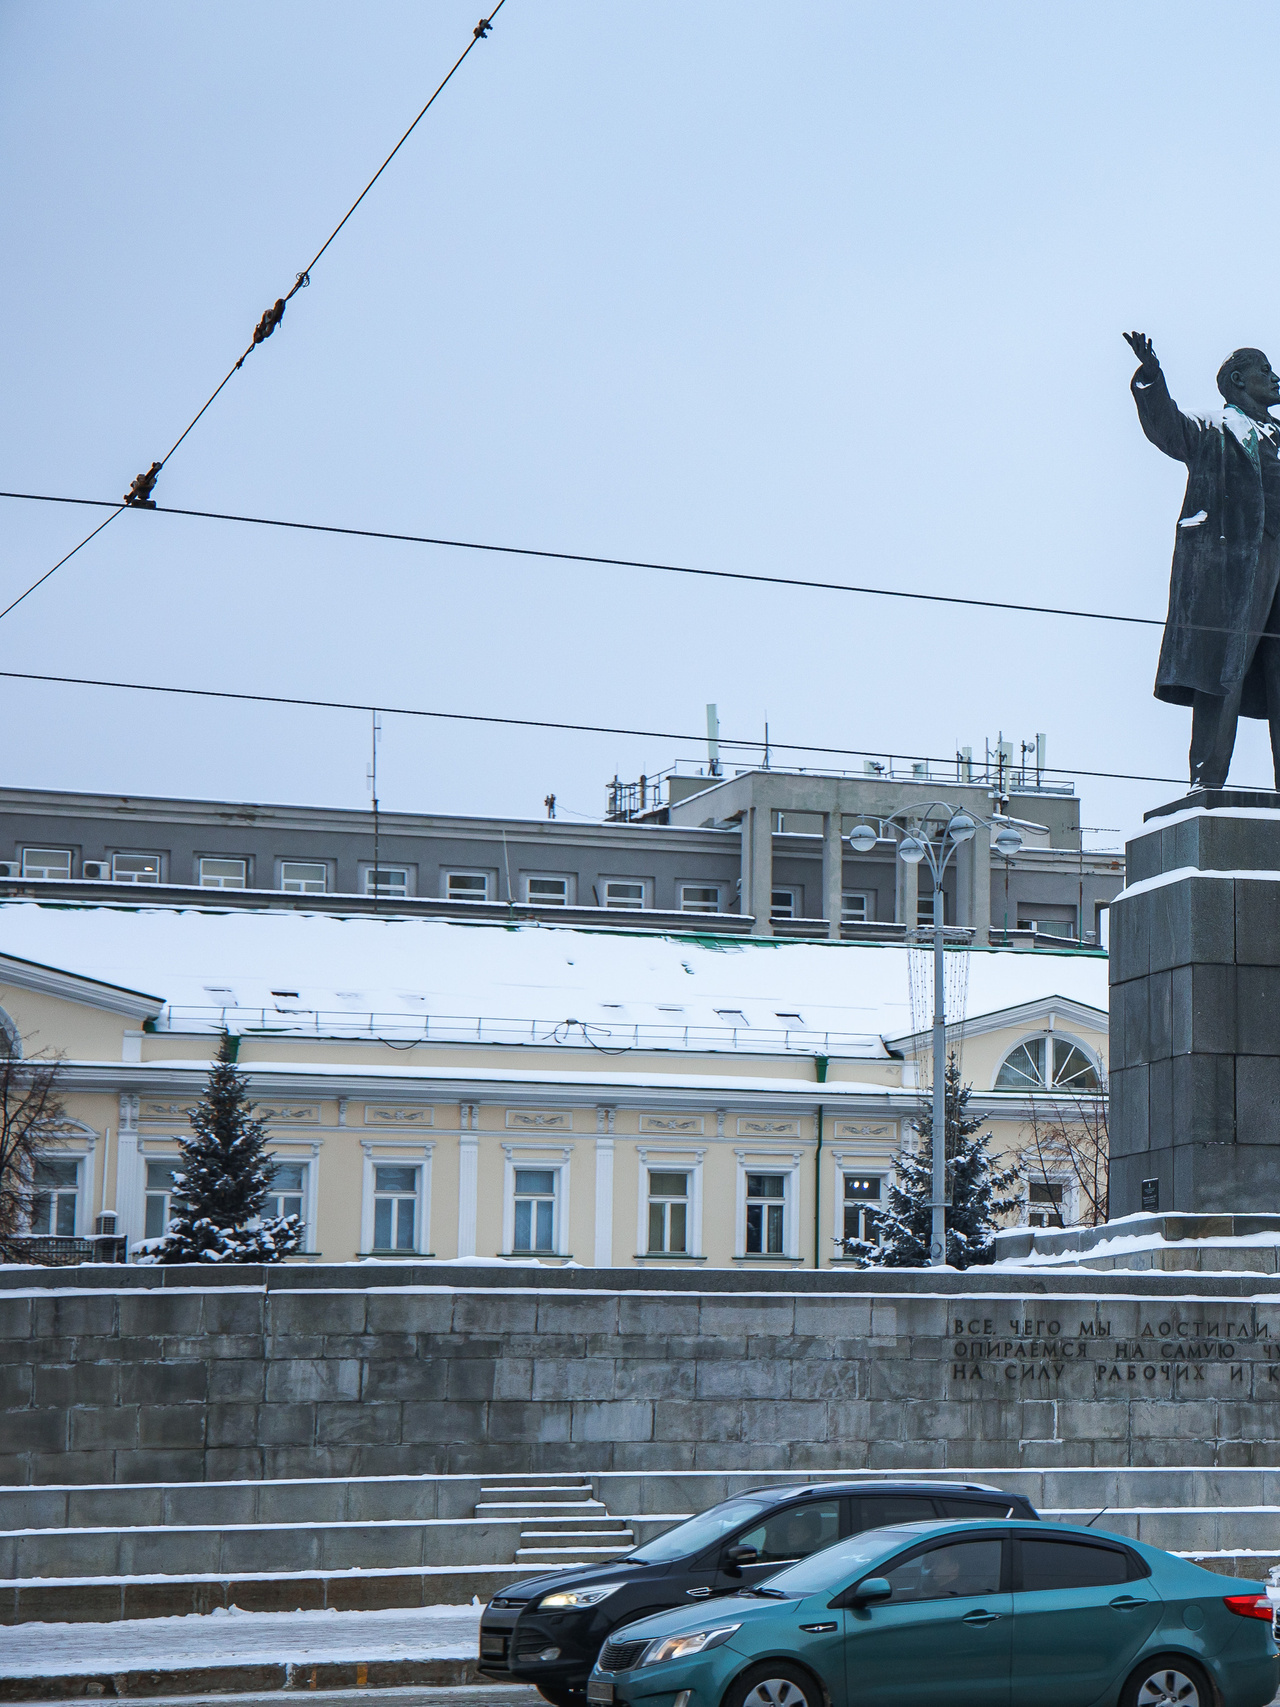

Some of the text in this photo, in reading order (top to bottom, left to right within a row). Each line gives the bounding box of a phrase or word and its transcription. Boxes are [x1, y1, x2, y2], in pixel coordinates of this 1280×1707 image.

[1010, 1320, 1061, 1336] ЧЕГО
[1079, 1320, 1111, 1336] МЫ
[953, 1341, 1088, 1358] ОПИРАЕМСЯ
[1115, 1342, 1145, 1358] НА
[1160, 1342, 1235, 1359] САМУЮ
[953, 1364, 983, 1380] НА
[1004, 1364, 1065, 1381] СИЛУ
[1098, 1365, 1205, 1382] РАБОЧИХ
[1230, 1366, 1244, 1382] И
